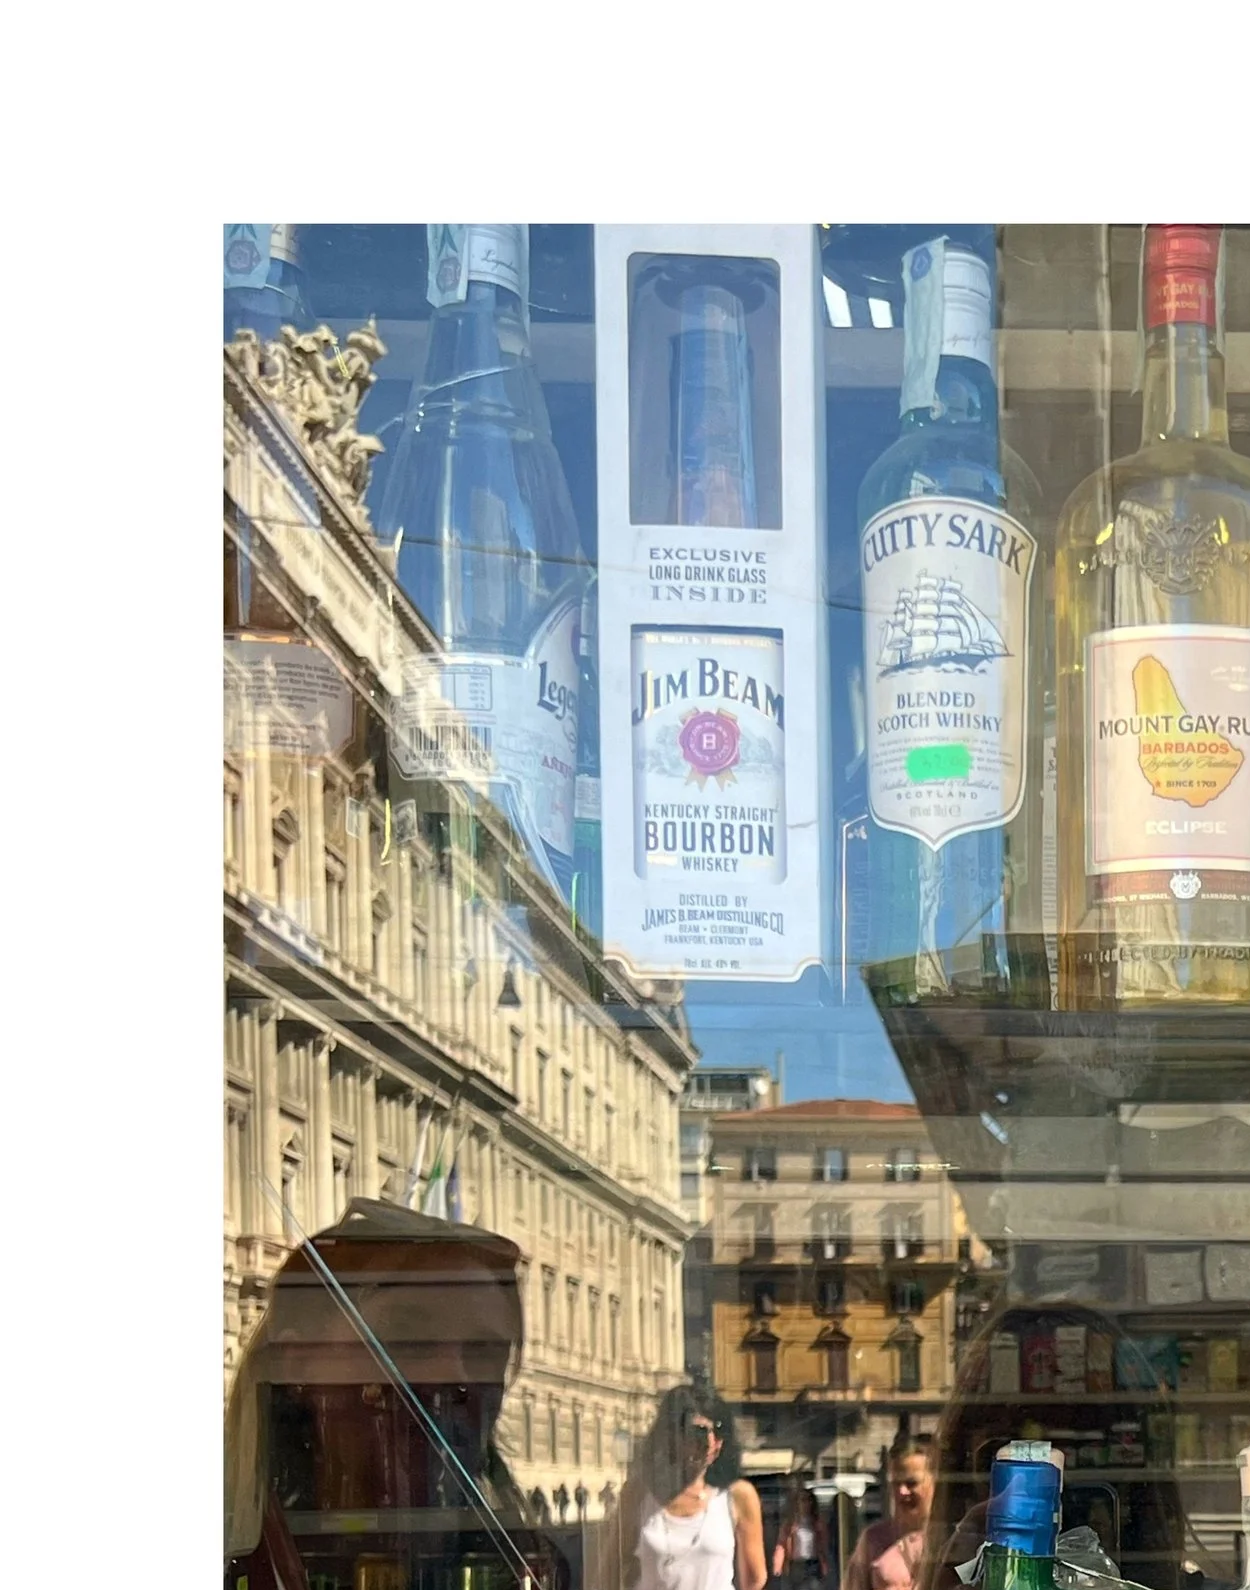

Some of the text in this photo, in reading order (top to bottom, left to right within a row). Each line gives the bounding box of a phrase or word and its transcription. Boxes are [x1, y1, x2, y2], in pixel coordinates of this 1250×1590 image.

[863, 513, 1026, 574] CUTTY SARK
[650, 548, 767, 564] EXCLUSIVE
[650, 565, 767, 583] LONG DRINK GLASS
[651, 585, 767, 604] INSIDE
[632, 658, 785, 732] JIM BEAM
[897, 692, 975, 709] BLENDED
[878, 712, 1002, 735] SCOTCH WHISKY
[1100, 716, 1173, 740] MOUNT
[1178, 715, 1221, 734] GAY
[1142, 742, 1230, 755] BARBADOS
[1166, 780, 1194, 788] SINCE
[897, 789, 978, 801] SCOTLAND
[645, 804, 775, 823] KENTUCKY STRAIGHT
[1145, 821, 1227, 834] ECLIPSE
[645, 821, 774, 857] BOURBON
[682, 856, 739, 872] WHISKEY
[679, 894, 748, 907] DISTILLED BY
[642, 909, 676, 932] JAMES
[688, 909, 714, 922] BEAM
[717, 911, 767, 929] DISTILLING
